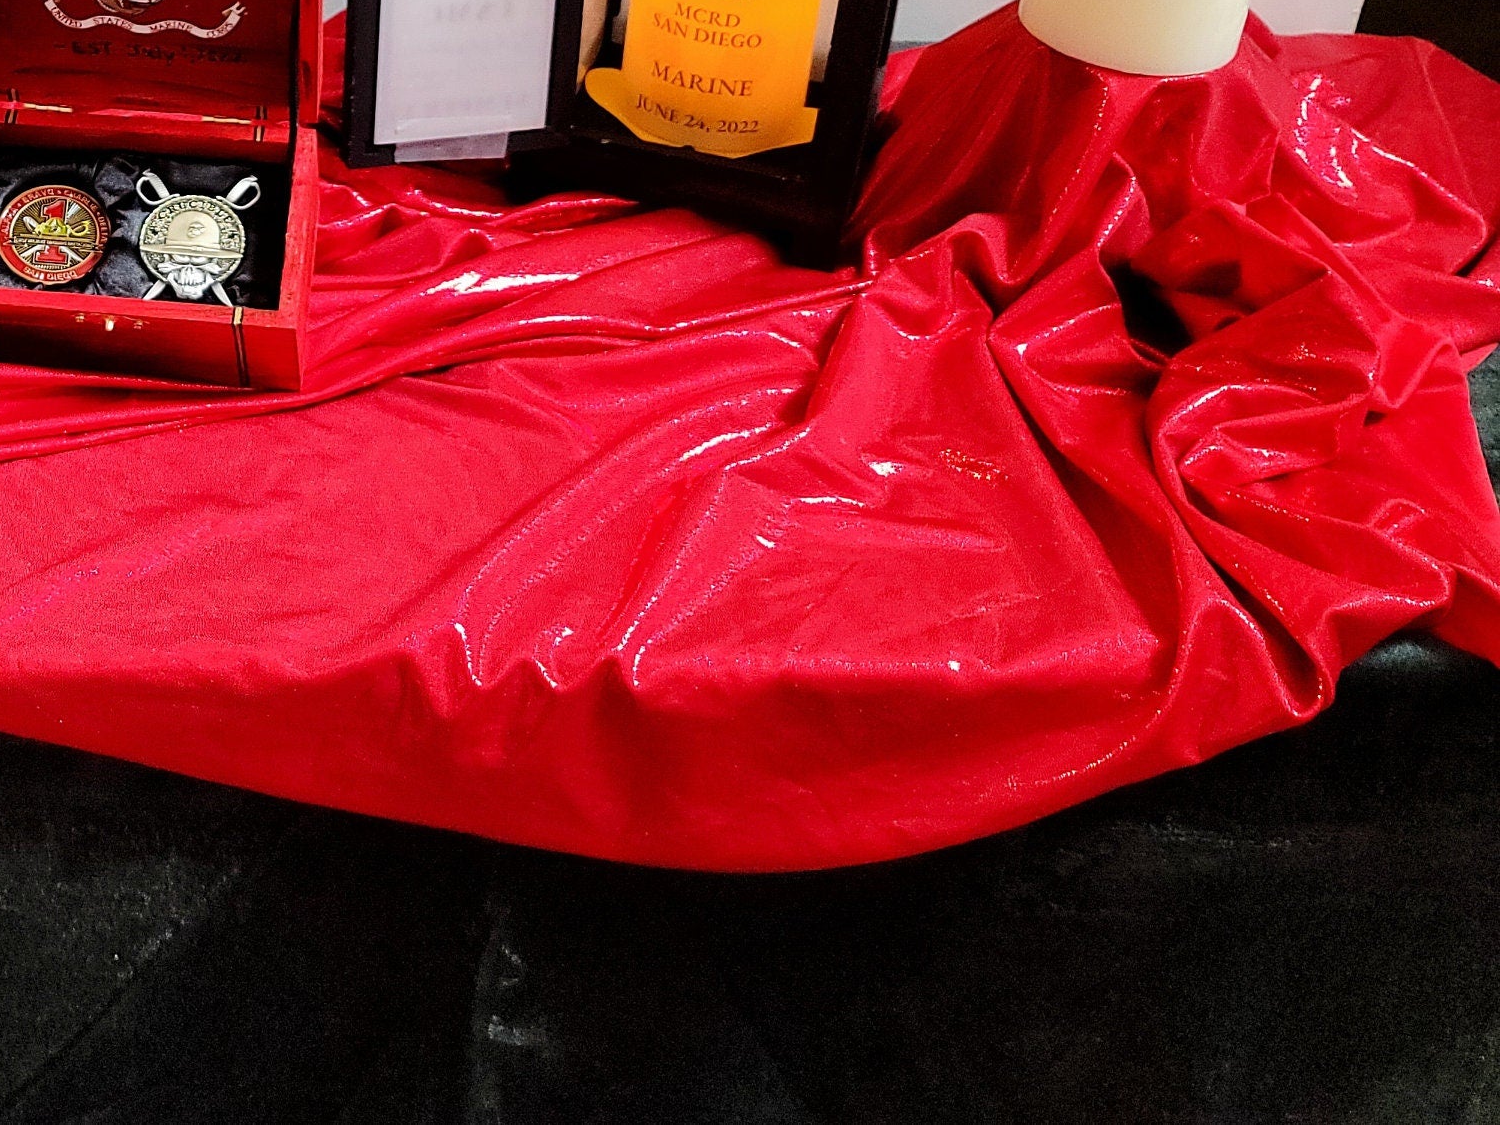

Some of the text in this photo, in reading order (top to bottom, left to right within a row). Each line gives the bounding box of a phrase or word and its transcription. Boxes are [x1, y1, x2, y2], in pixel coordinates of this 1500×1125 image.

[50, 6, 84, 29] UNITED
[92, 15, 134, 31] STATES
[652, 12, 763, 49] SAN DIEGO
[674, 2, 742, 28] MCRD
[651, 60, 754, 97] MARINE
[636, 93, 680, 123] JUNE
[716, 119, 760, 133] 2022
